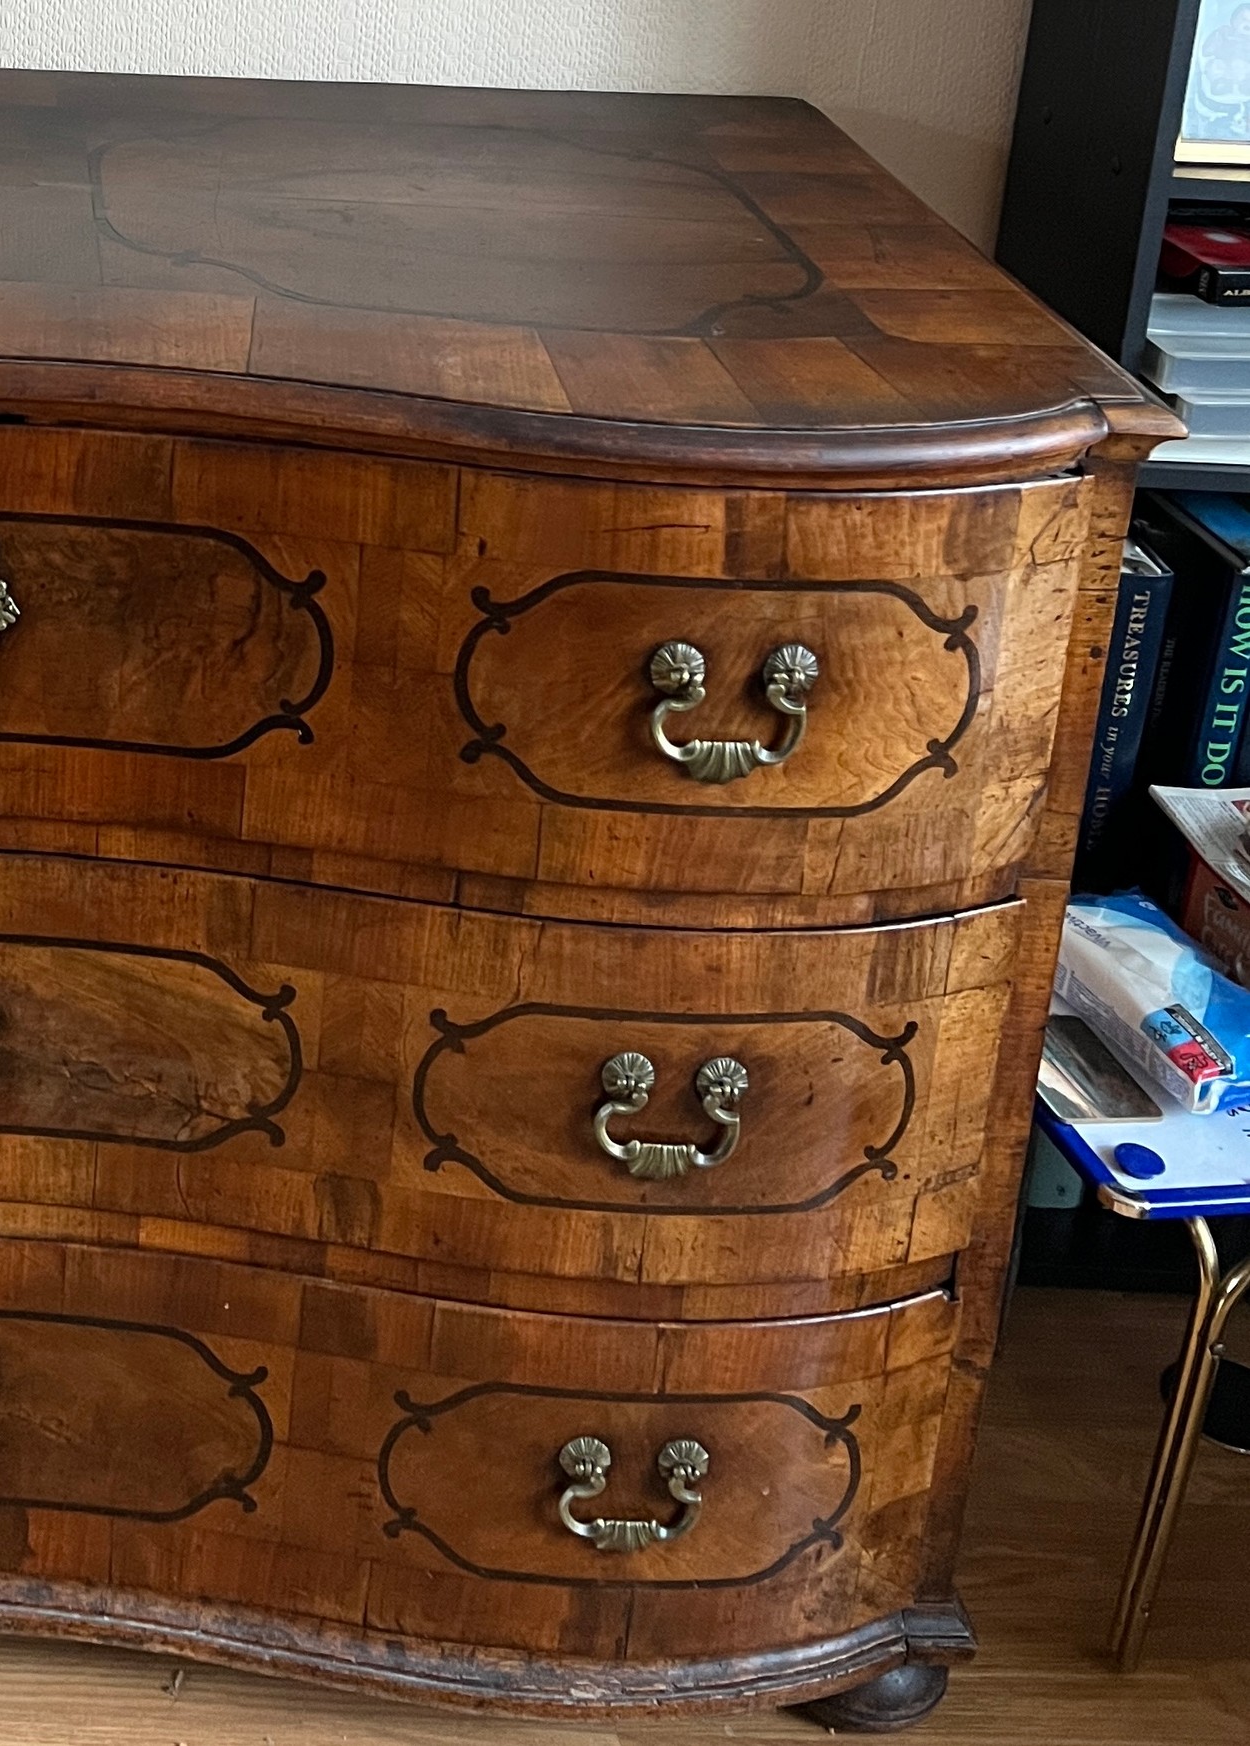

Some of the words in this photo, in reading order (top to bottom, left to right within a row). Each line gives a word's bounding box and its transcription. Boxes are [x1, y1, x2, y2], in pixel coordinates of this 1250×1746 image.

[1111, 590, 1150, 718] TREASURES
[1220, 667, 1248, 694] IS
[1106, 726, 1119, 742] in
[1211, 702, 1240, 733] IT
[1100, 742, 1115, 780] your
[1201, 741, 1232, 785] DO
